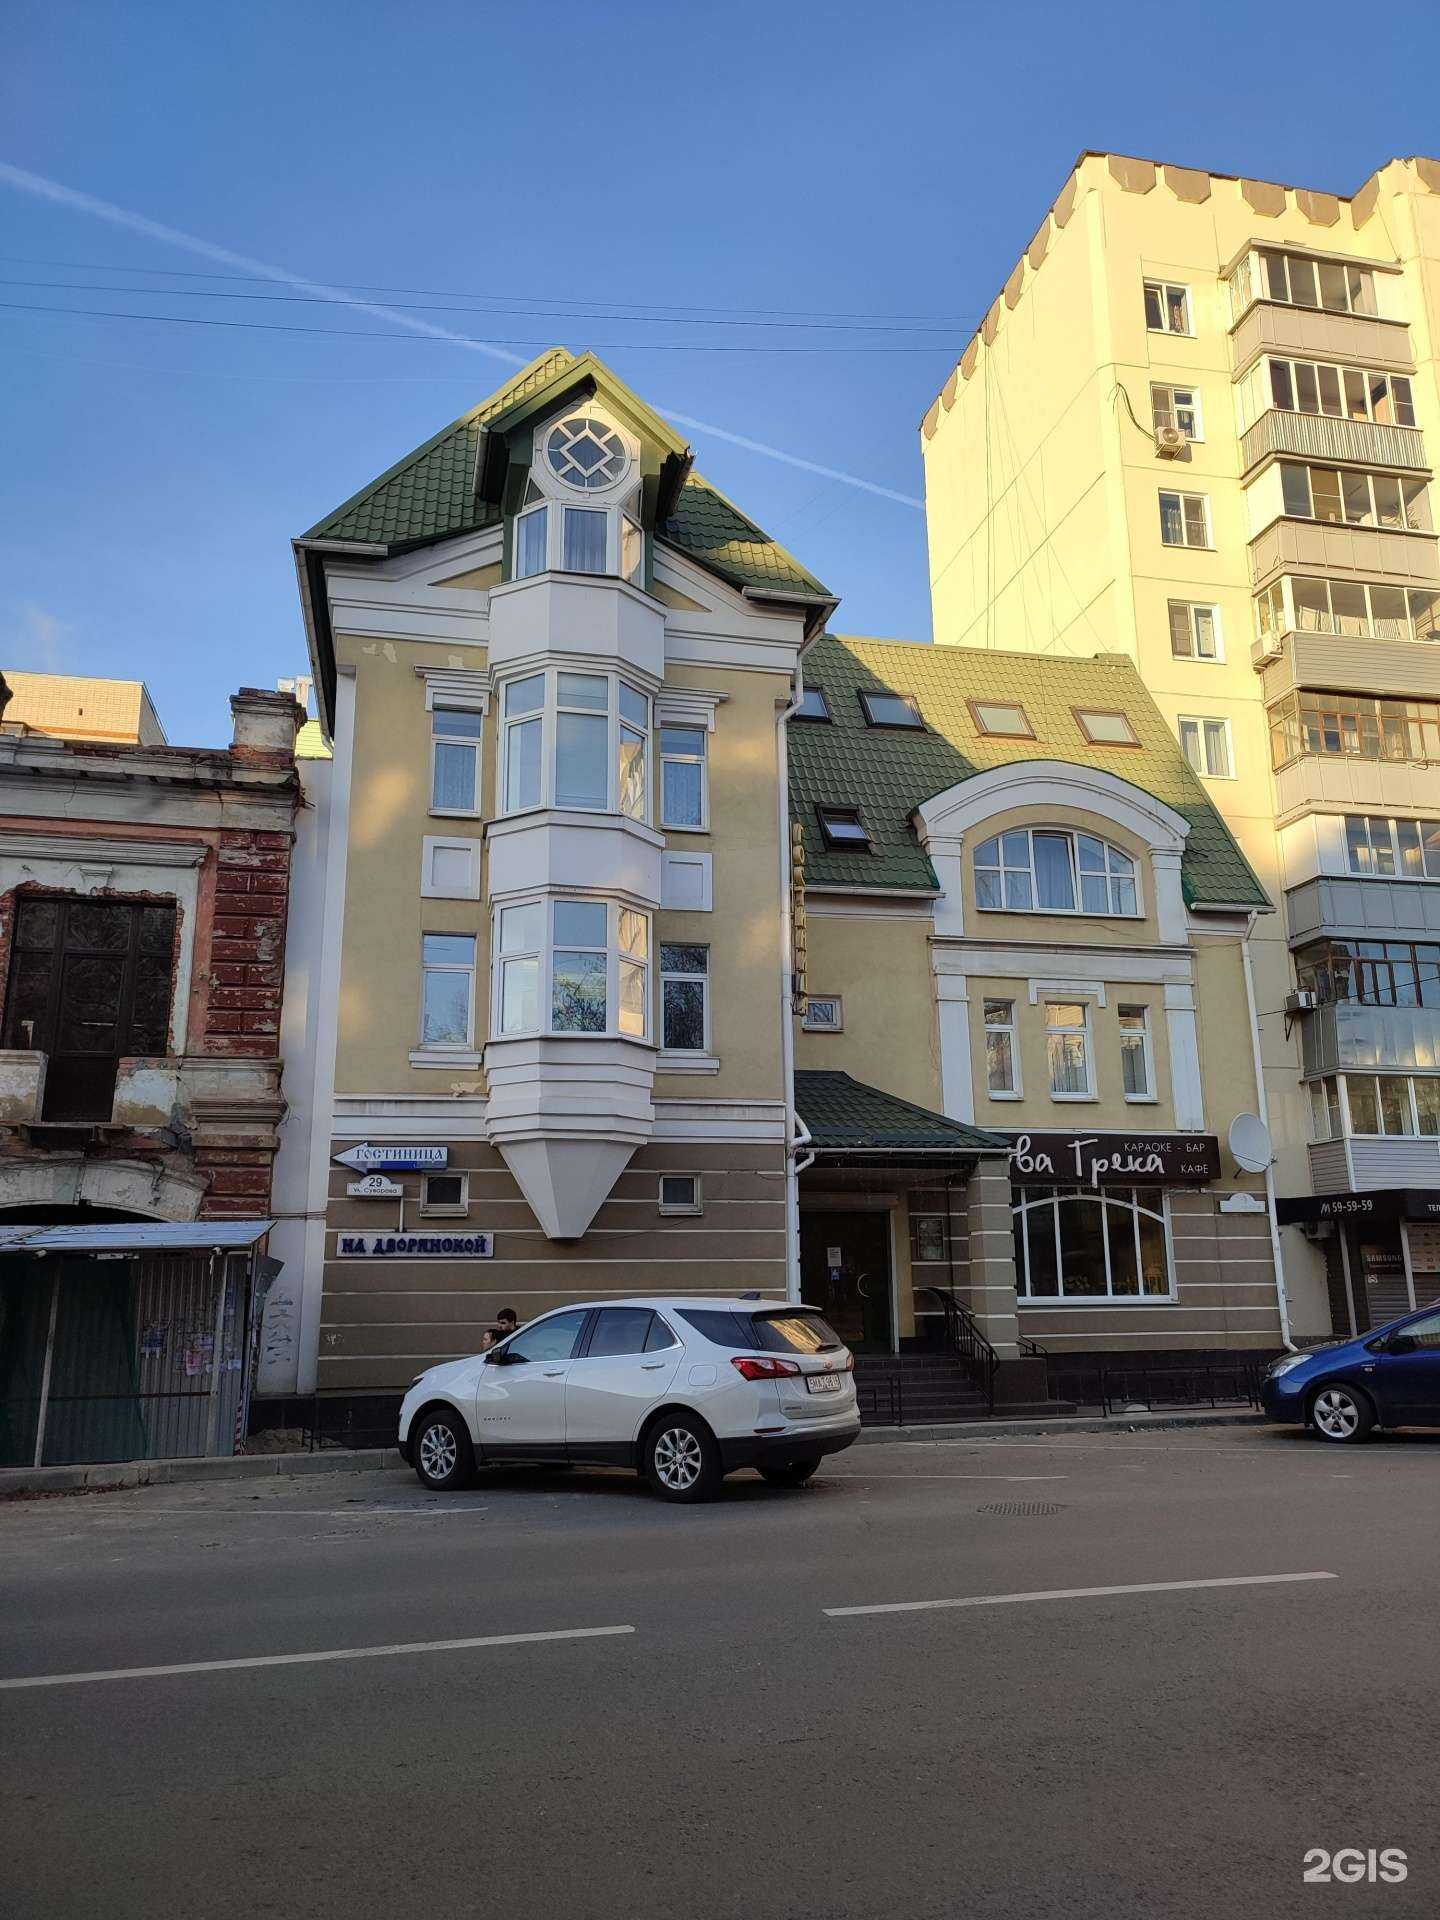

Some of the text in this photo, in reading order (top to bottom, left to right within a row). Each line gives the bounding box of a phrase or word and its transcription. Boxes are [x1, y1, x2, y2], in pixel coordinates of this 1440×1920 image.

[1009, 1135, 1055, 1173] ва
[1124, 1142, 1172, 1153] КАРАОКЕ
[1186, 1142, 1206, 1153] БАР
[355, 1148, 444, 1163] ГОСТИНИЦА
[1180, 1163, 1209, 1174] КАФЕ
[368, 1177, 383, 1187] 29
[1332, 1199, 1373, 1213] 59-59-59
[341, 1238, 367, 1253] НА
